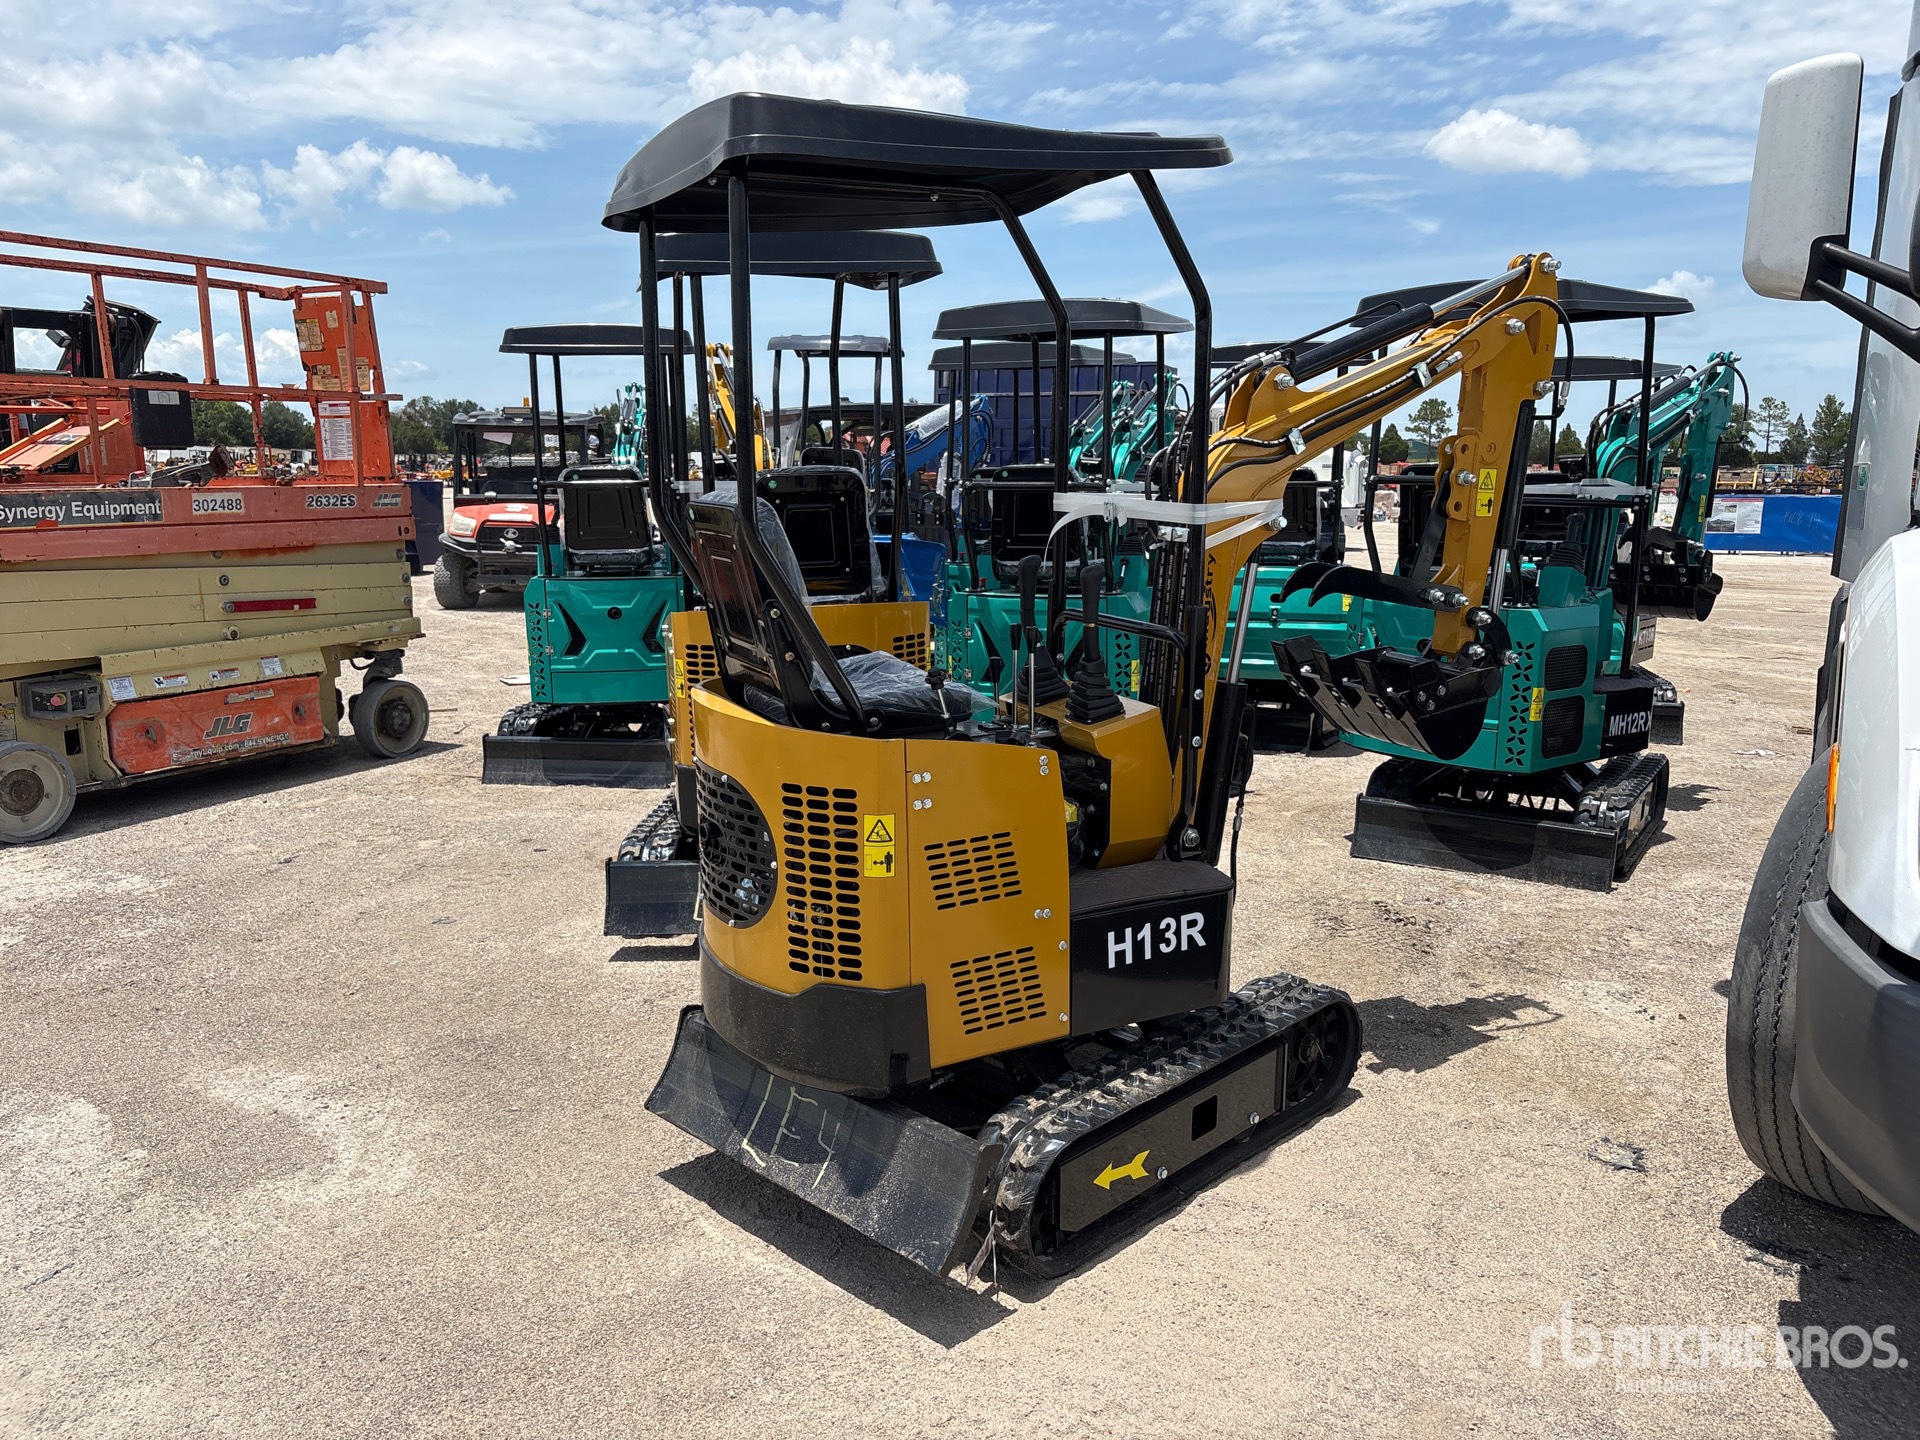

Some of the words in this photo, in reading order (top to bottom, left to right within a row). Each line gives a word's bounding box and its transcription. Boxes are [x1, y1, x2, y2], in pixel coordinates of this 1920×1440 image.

[0, 503, 66, 524] Synergy
[71, 499, 162, 520] Equipment
[193, 498, 243, 512] 302488
[306, 494, 356, 508] 2632ES
[203, 711, 253, 740] JLG
[1107, 912, 1207, 969] H13R
